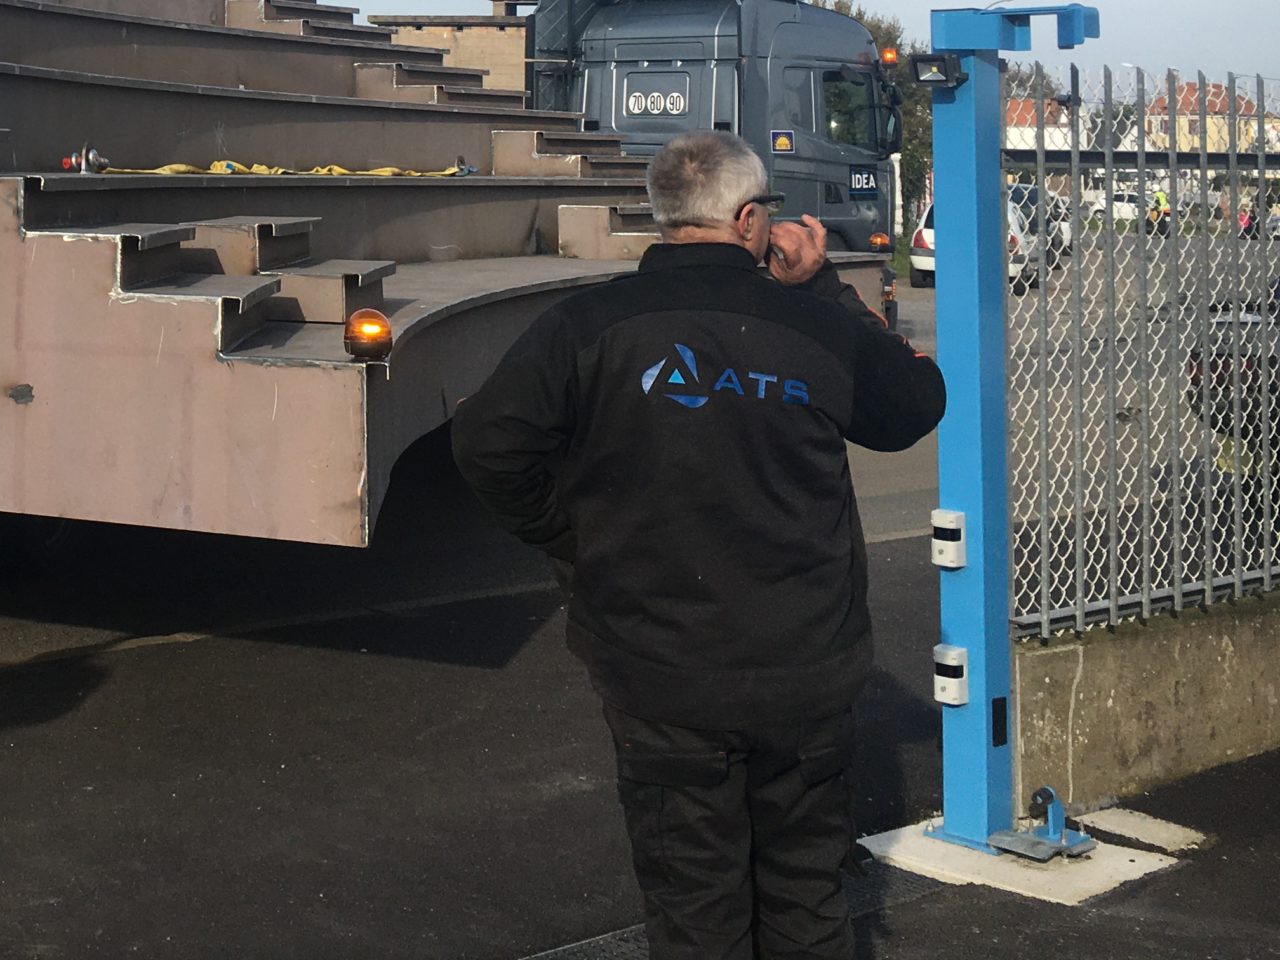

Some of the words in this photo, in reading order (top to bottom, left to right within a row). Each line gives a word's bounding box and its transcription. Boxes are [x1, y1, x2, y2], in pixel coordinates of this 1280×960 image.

[632, 95, 643, 111] 70
[650, 95, 662, 111] 80
[669, 95, 681, 111] 90
[851, 173, 876, 189] IDEA
[713, 367, 810, 405] ATS
